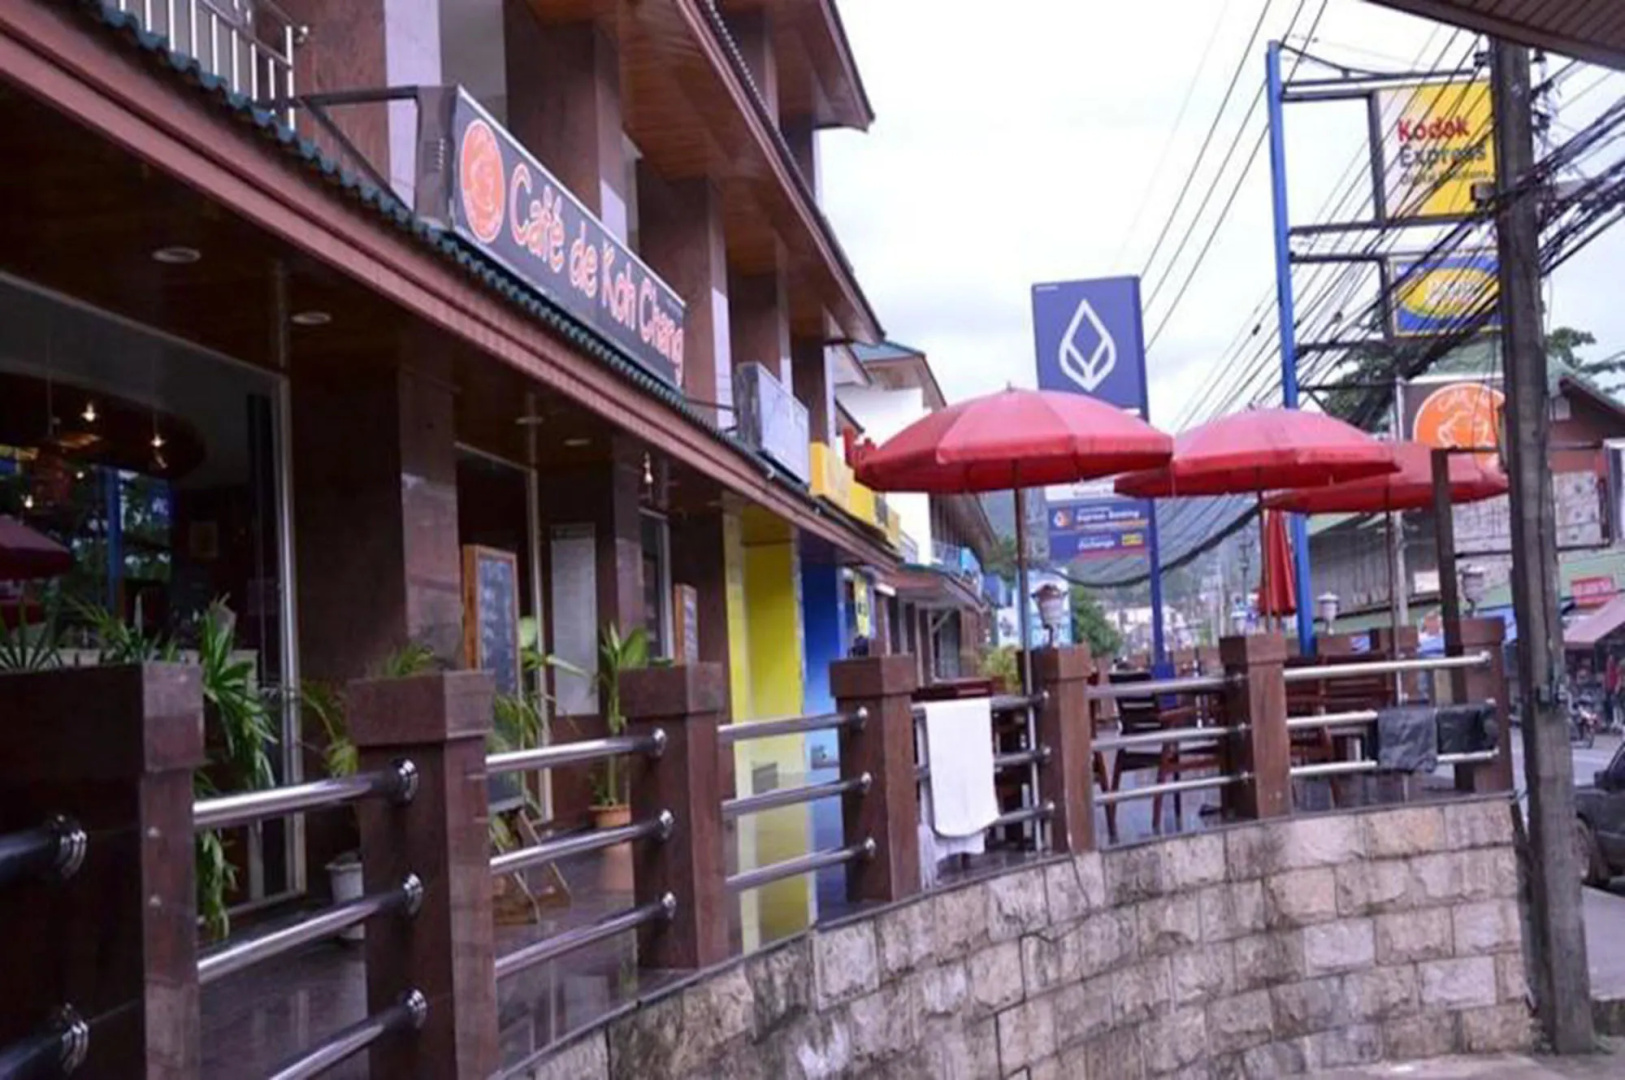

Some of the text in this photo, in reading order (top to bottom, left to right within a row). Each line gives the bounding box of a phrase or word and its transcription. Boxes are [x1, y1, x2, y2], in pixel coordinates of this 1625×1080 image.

[1397, 116, 1470, 141] Kodak
[569, 220, 598, 298] de
[602, 240, 636, 331] Koh
